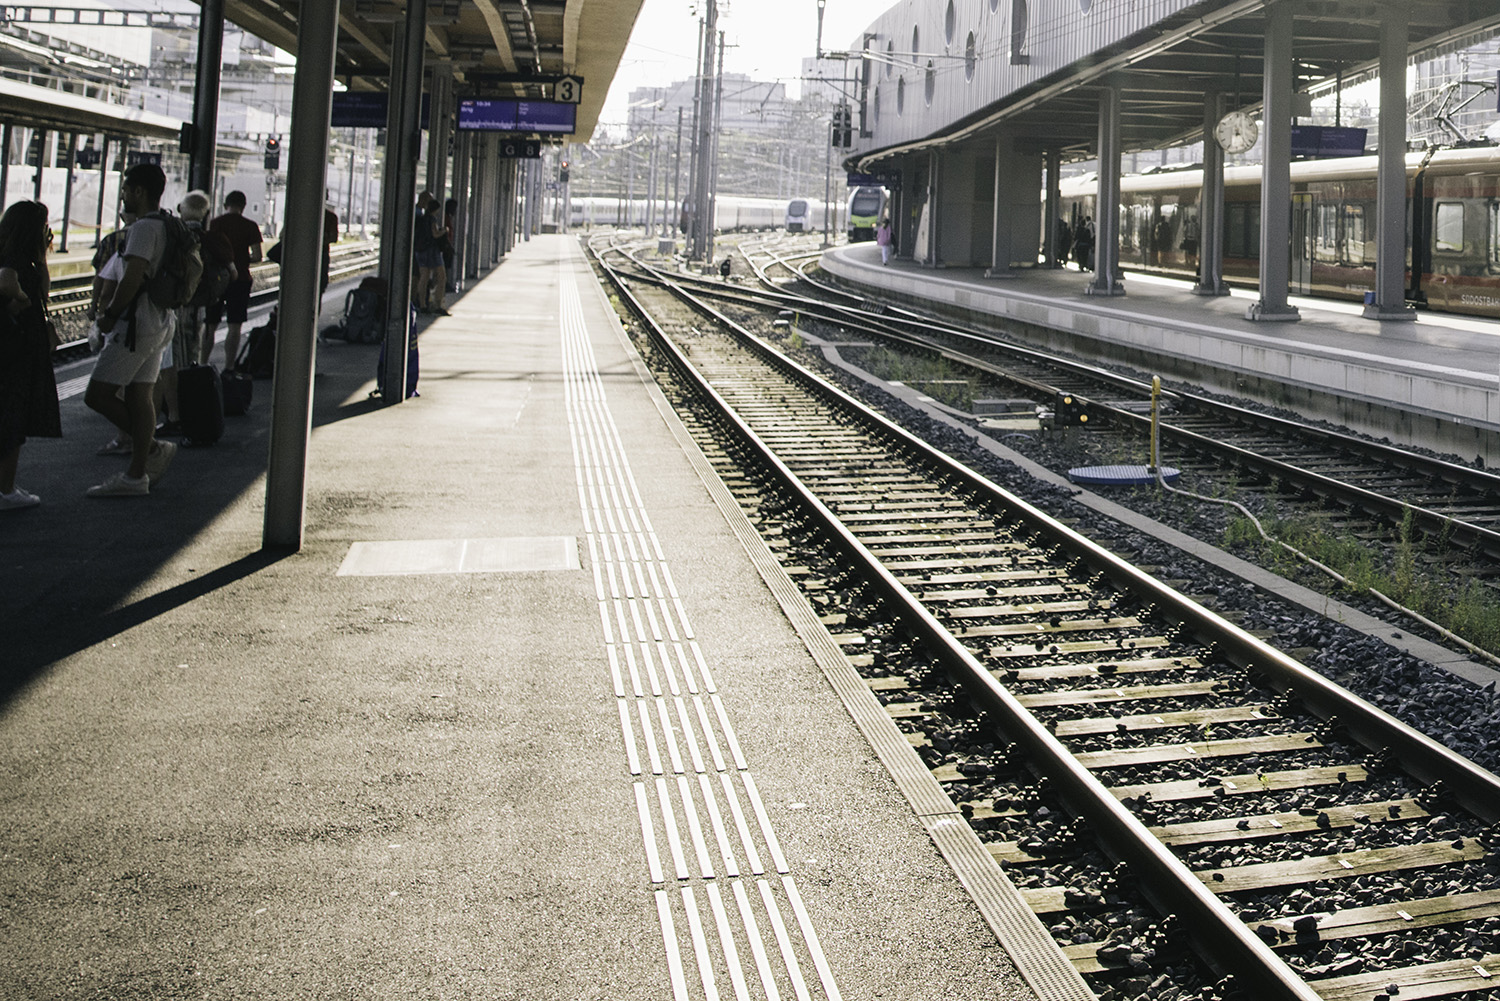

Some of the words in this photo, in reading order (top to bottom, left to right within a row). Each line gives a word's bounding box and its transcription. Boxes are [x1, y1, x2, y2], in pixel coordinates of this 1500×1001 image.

[561, 81, 573, 100] 3
[505, 144, 515, 155] G
[526, 145, 534, 156] 8
